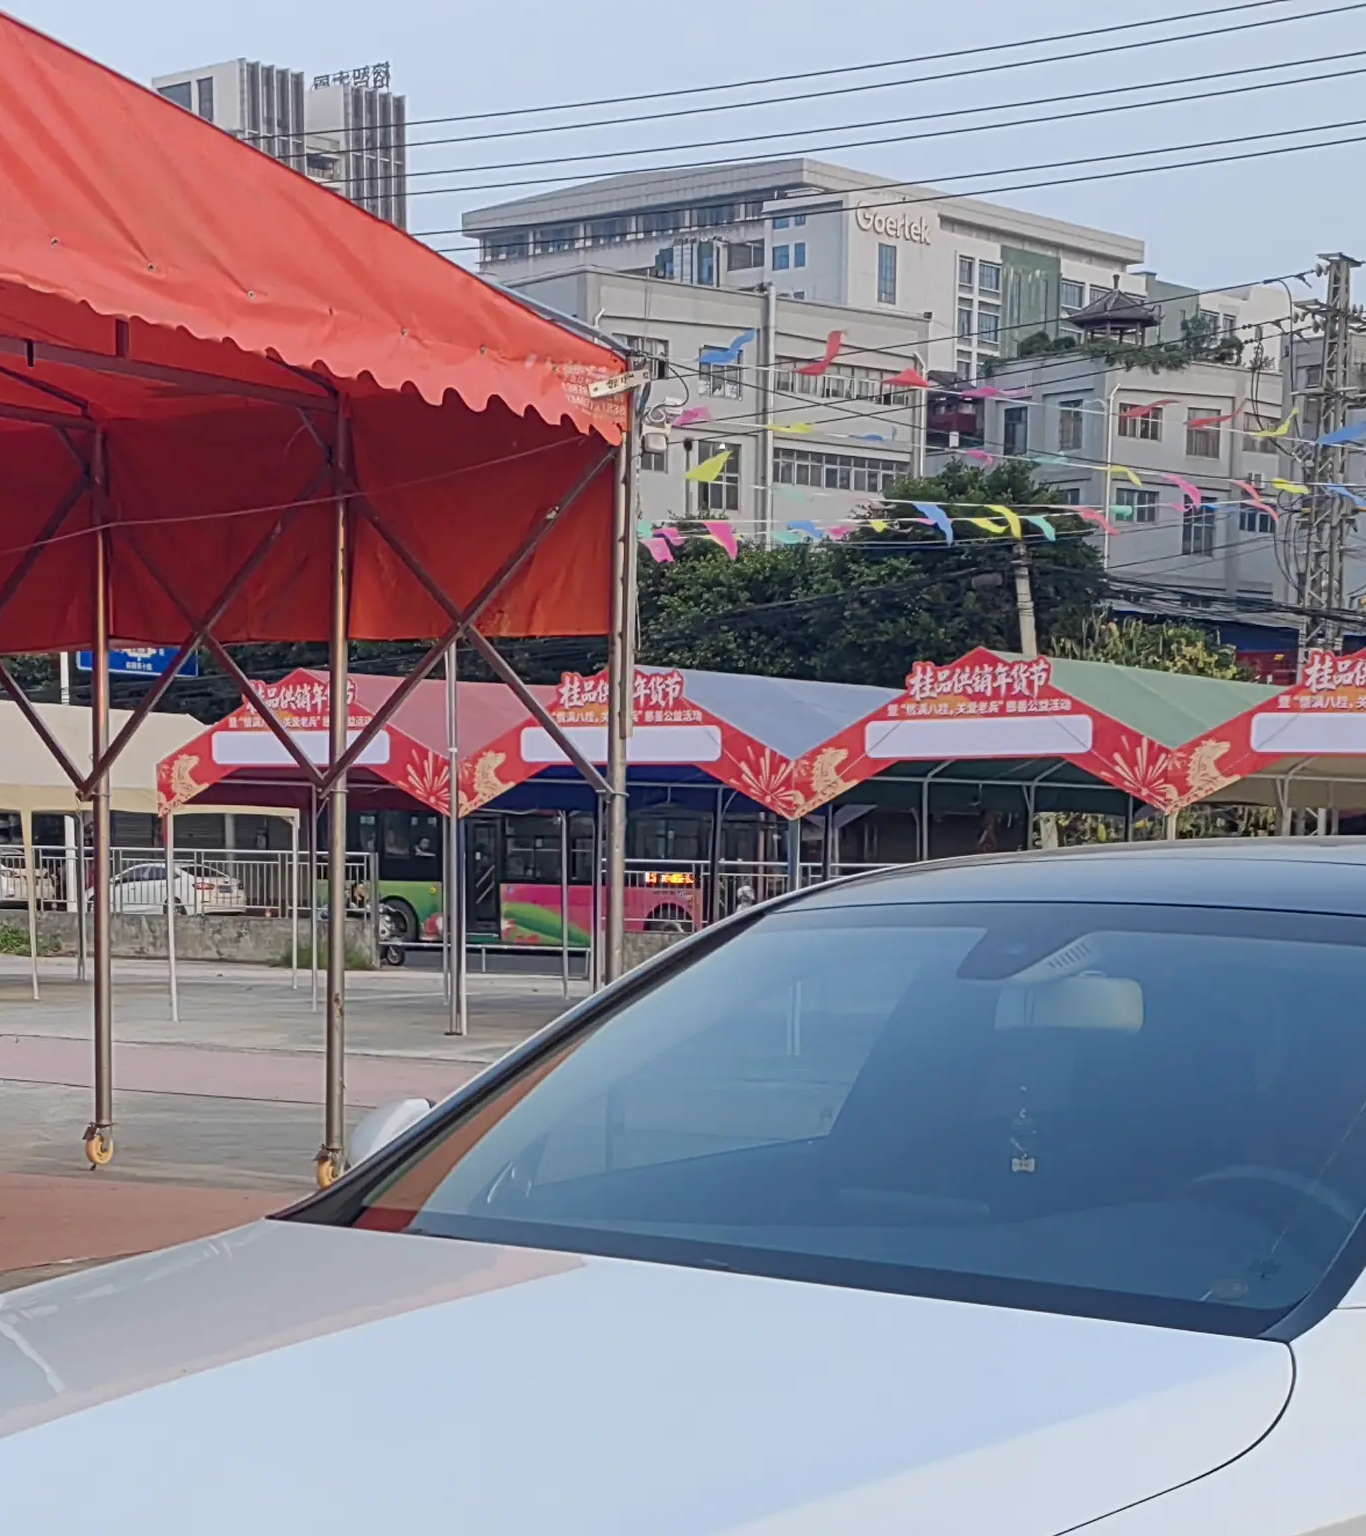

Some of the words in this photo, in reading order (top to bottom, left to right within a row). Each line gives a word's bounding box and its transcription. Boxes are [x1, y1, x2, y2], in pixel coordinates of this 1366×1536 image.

[856, 201, 931, 246] Goertek
[246, 682, 356, 714] 桂品供销年节
[559, 673, 682, 709] 桂品供年货节
[909, 660, 1050, 701] 桂品供销年货节
